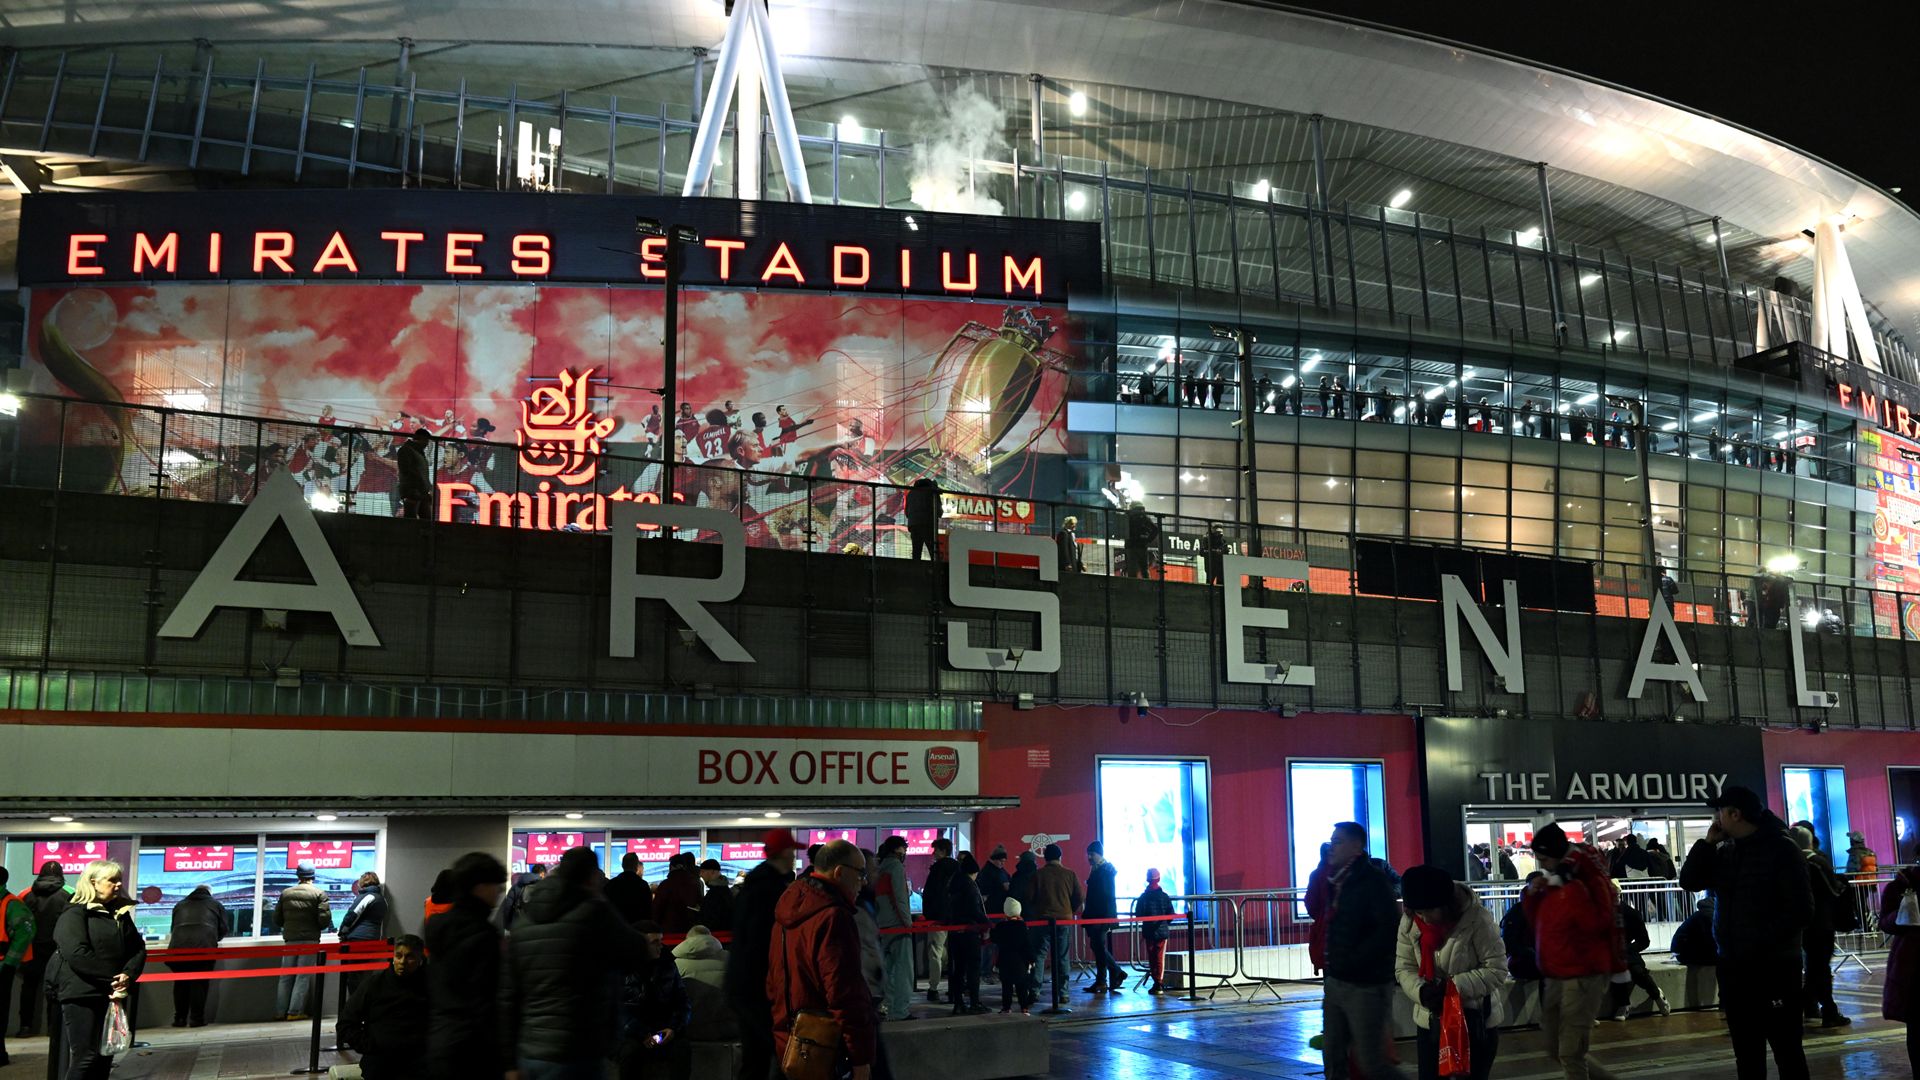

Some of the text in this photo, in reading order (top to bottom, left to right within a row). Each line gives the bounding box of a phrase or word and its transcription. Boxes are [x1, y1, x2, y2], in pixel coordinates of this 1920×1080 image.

[66, 231, 1044, 295] EMIRATES STADIUM
[704, 437, 723, 459] 23
[1168, 535, 1191, 551] The
[1261, 545, 1306, 560] ATCHDAY
[157, 467, 1840, 708] ARSENAL
[698, 749, 910, 785] BOX OFFICE
[1479, 771, 1728, 801] THE ARMOURY
[176, 860, 222, 869] SOLD OUT
[322, 858, 341, 866] OUT
[536, 854, 558, 862] SOLD
